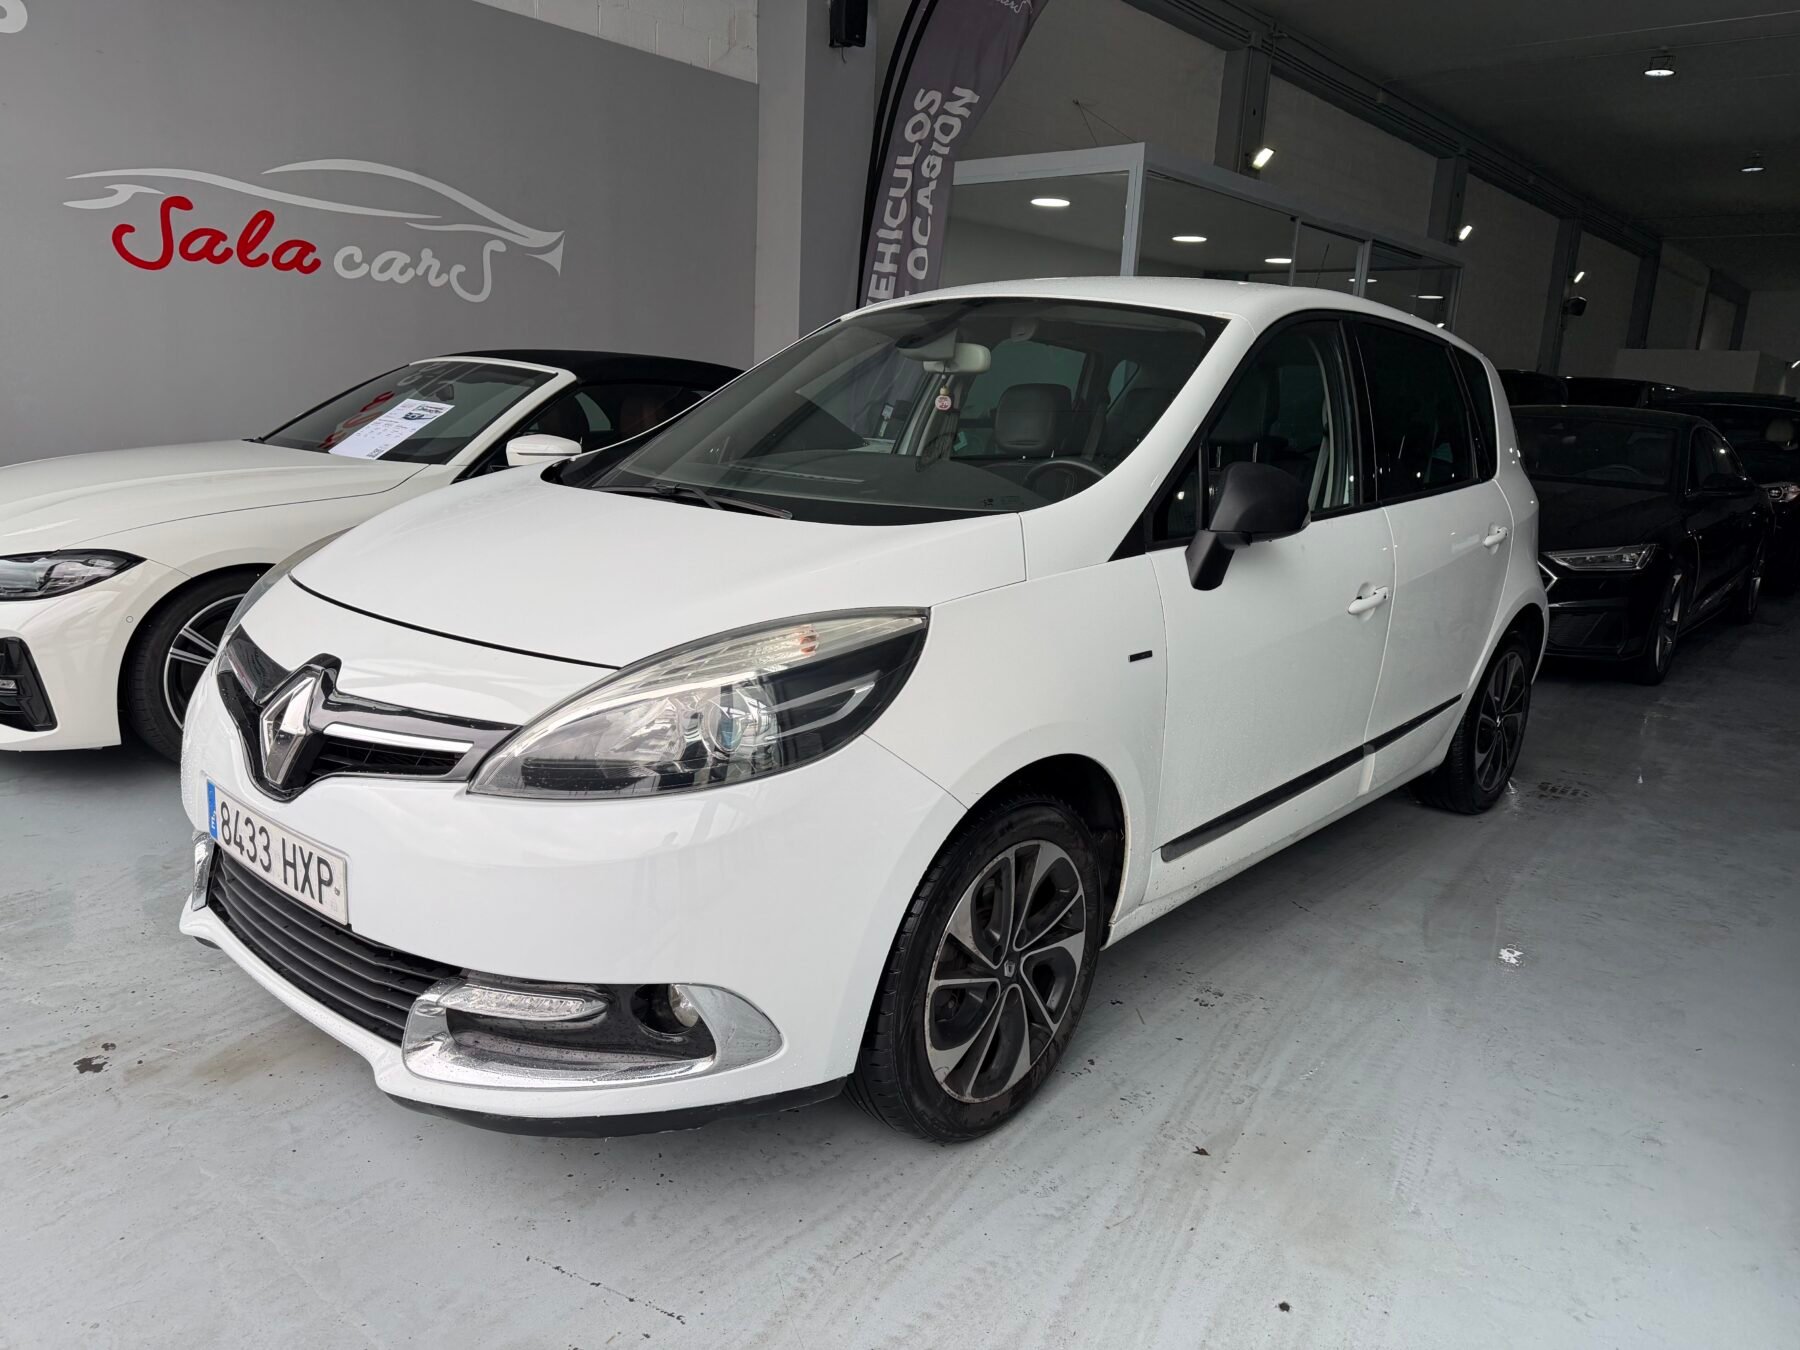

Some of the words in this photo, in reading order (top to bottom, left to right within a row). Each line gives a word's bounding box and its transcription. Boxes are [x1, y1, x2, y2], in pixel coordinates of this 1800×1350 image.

[112, 195, 321, 275] Sala
[866, 88, 942, 306] EHICULOS
[907, 86, 980, 280] OCASION
[220, 801, 272, 873] 8433
[282, 837, 334, 905] HXP
